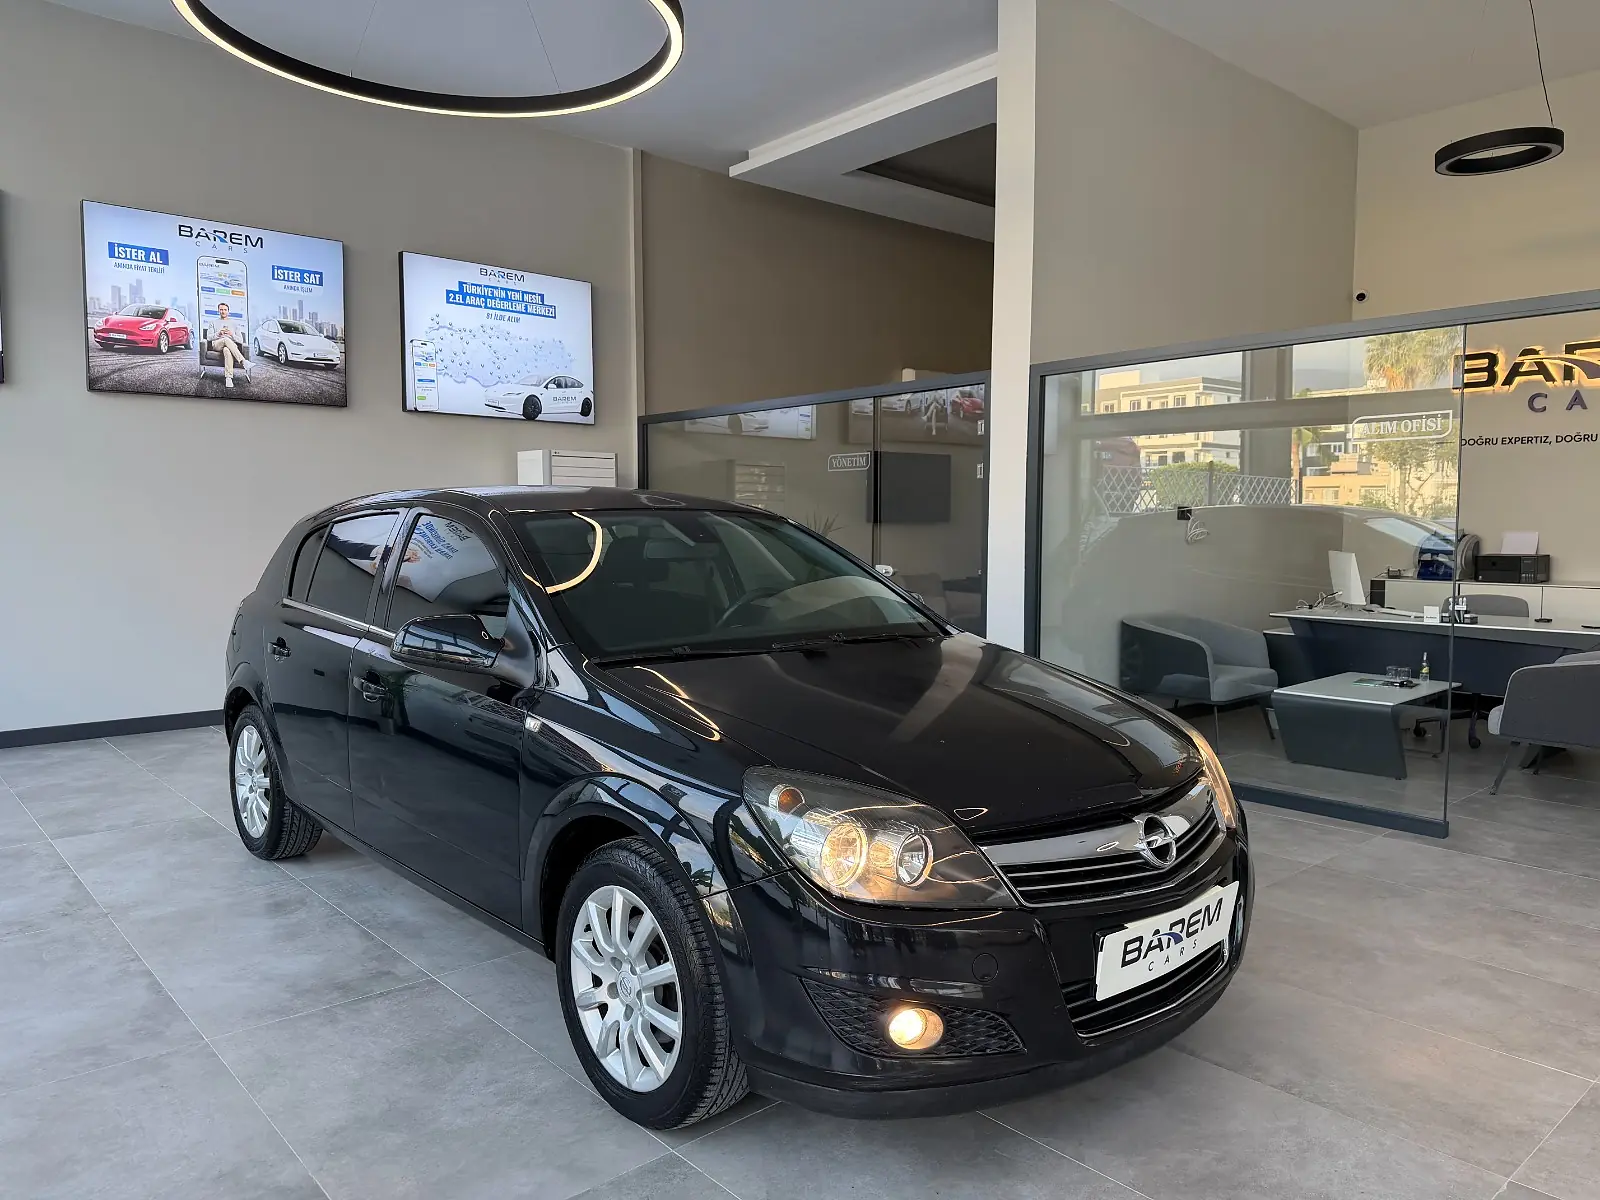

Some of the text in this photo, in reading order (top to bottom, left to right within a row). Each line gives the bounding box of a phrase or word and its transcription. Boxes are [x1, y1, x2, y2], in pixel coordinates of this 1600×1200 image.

[178, 224, 264, 249] BAREM
[195, 240, 248, 254] CARS
[114, 243, 163, 263] İSTER AL
[274, 265, 321, 285] İSTER SAT
[480, 267, 525, 283] BAREM
[462, 282, 543, 305] TÜRKİYE'NİN YENİ NESİL
[449, 294, 555, 317] 2.EL ARAÇ DEĞERLEME MERKEZİ
[1361, 414, 1443, 436] ALIM OFİSİ
[1501, 434, 1552, 446] EXPERTIZ,
[1555, 431, 1598, 444] DOĞRU
[832, 456, 867, 467] YÖNETİM
[1120, 897, 1223, 969] BAREM
[1148, 937, 1199, 972] CARS
